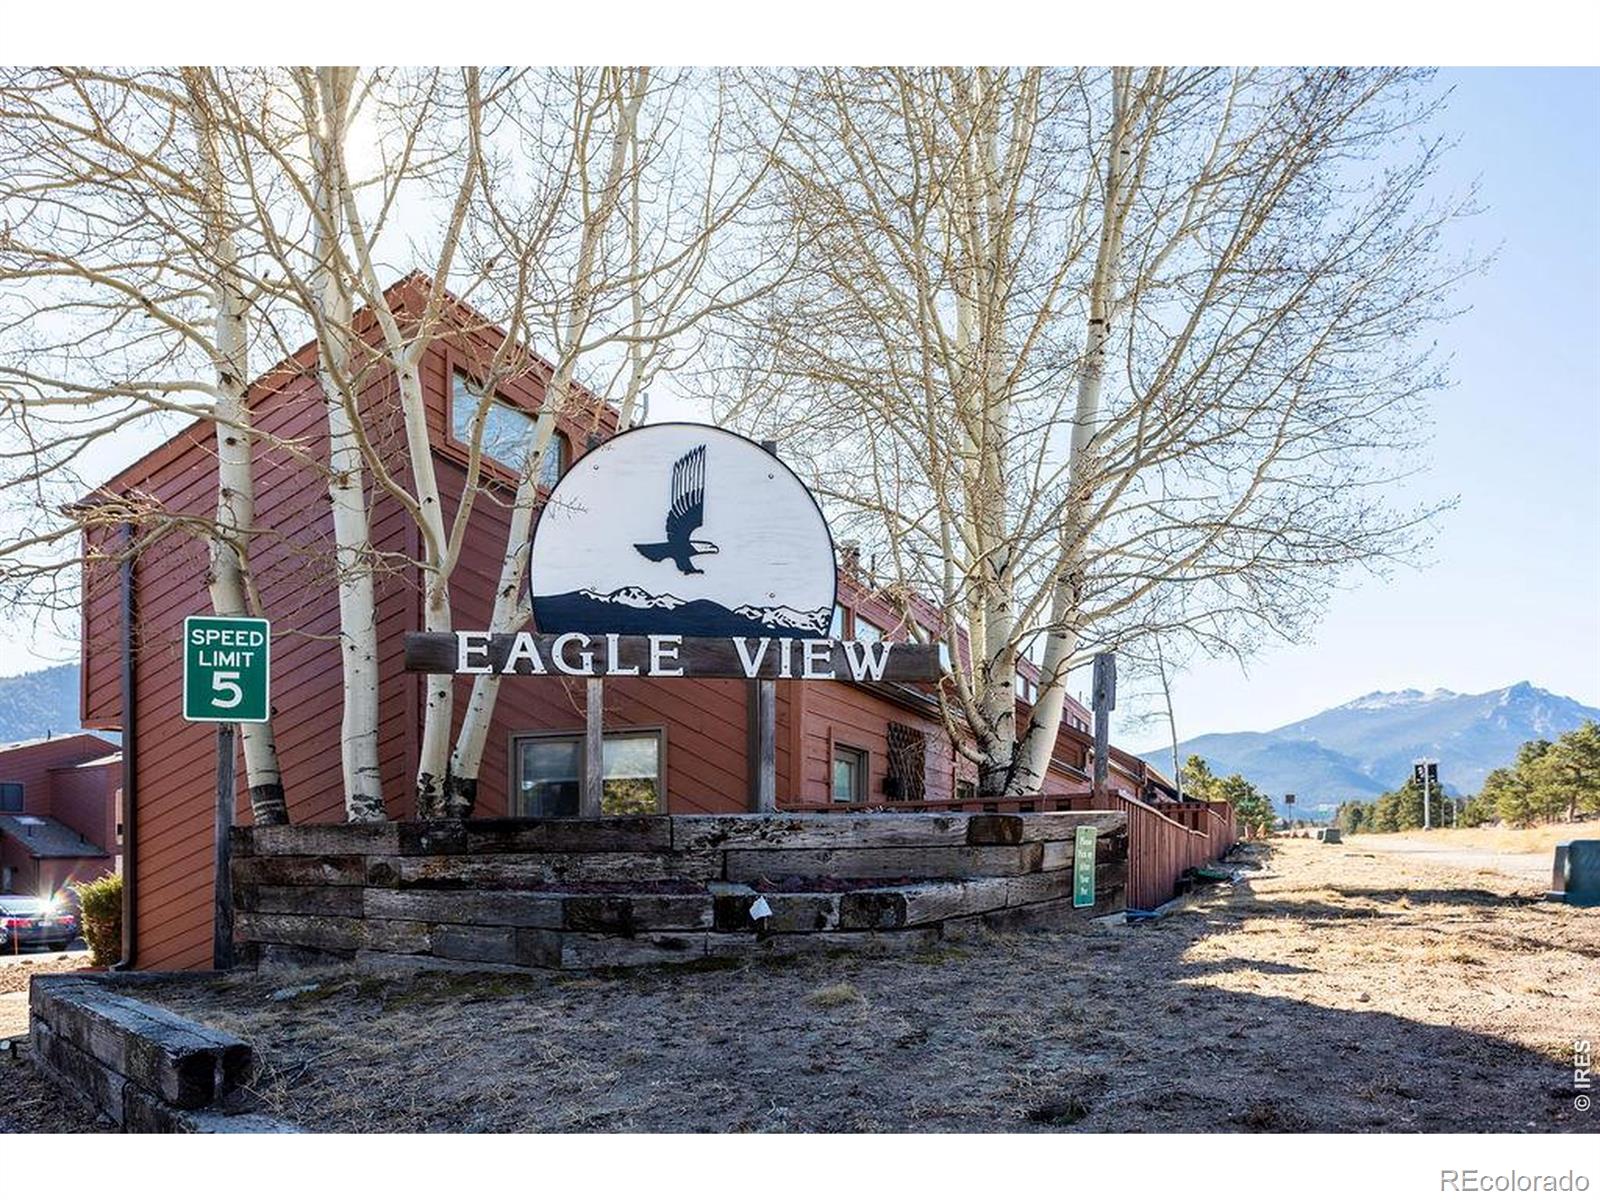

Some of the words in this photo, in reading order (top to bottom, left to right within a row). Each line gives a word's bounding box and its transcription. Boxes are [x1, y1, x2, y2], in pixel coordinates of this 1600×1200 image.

[191, 629, 264, 647] SPEED
[199, 650, 255, 668] LIMIT
[455, 631, 684, 676] EAGLE
[732, 636, 892, 681] VIEW
[211, 671, 243, 708] 5
